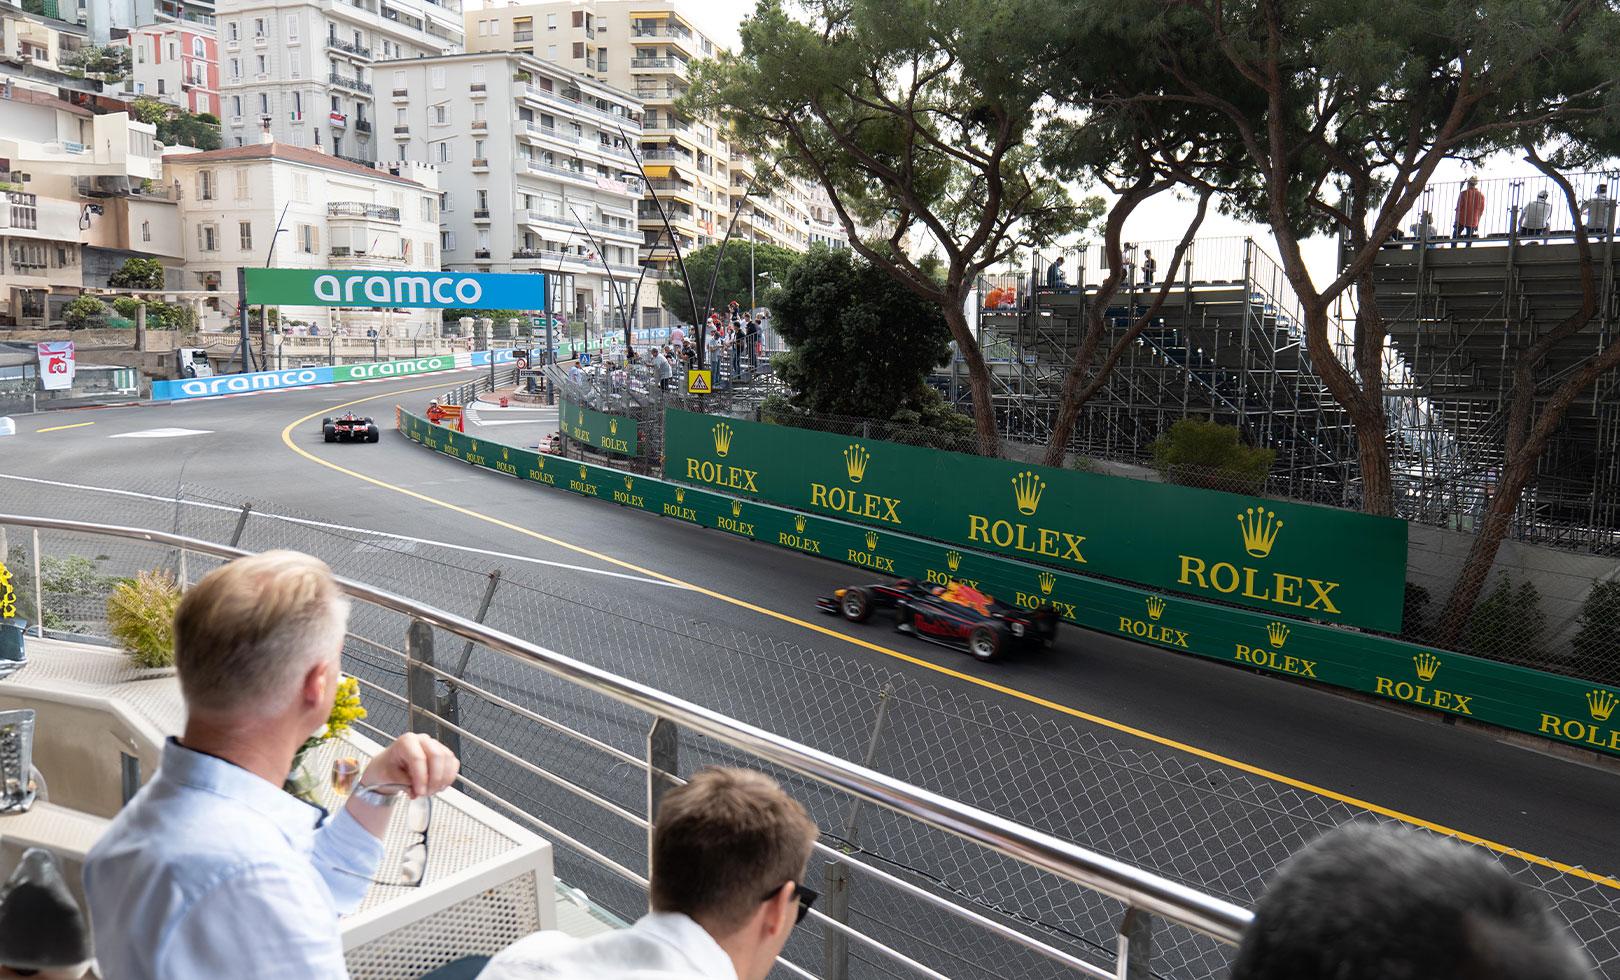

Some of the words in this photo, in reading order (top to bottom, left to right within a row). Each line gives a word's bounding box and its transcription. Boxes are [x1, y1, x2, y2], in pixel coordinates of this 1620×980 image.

[313, 274, 483, 304] aramco
[350, 357, 442, 378] aramco
[182, 369, 317, 395] aramco
[444, 444, 460, 457] ROLEX
[601, 436, 628, 453] ROLEX
[466, 452, 486, 466] ROLEX
[496, 461, 517, 475] ROLEX
[529, 469, 555, 485] ROLEX
[686, 458, 759, 493] ROLEX
[570, 480, 598, 496] ROLEX
[613, 490, 644, 508] ROLEX
[663, 503, 697, 522] ROLEX
[810, 483, 902, 524] ROLEX
[718, 516, 755, 537] ROLEX
[779, 532, 821, 553] ROLEX
[967, 515, 1088, 564] ROLEX
[847, 549, 895, 573] ROLEX
[926, 568, 980, 591] ROX
[1177, 555, 1341, 614] ROLEX
[1118, 616, 1189, 648] ROLEX
[1234, 644, 1318, 678] ROLEX
[1375, 676, 1473, 715] ROLEX
